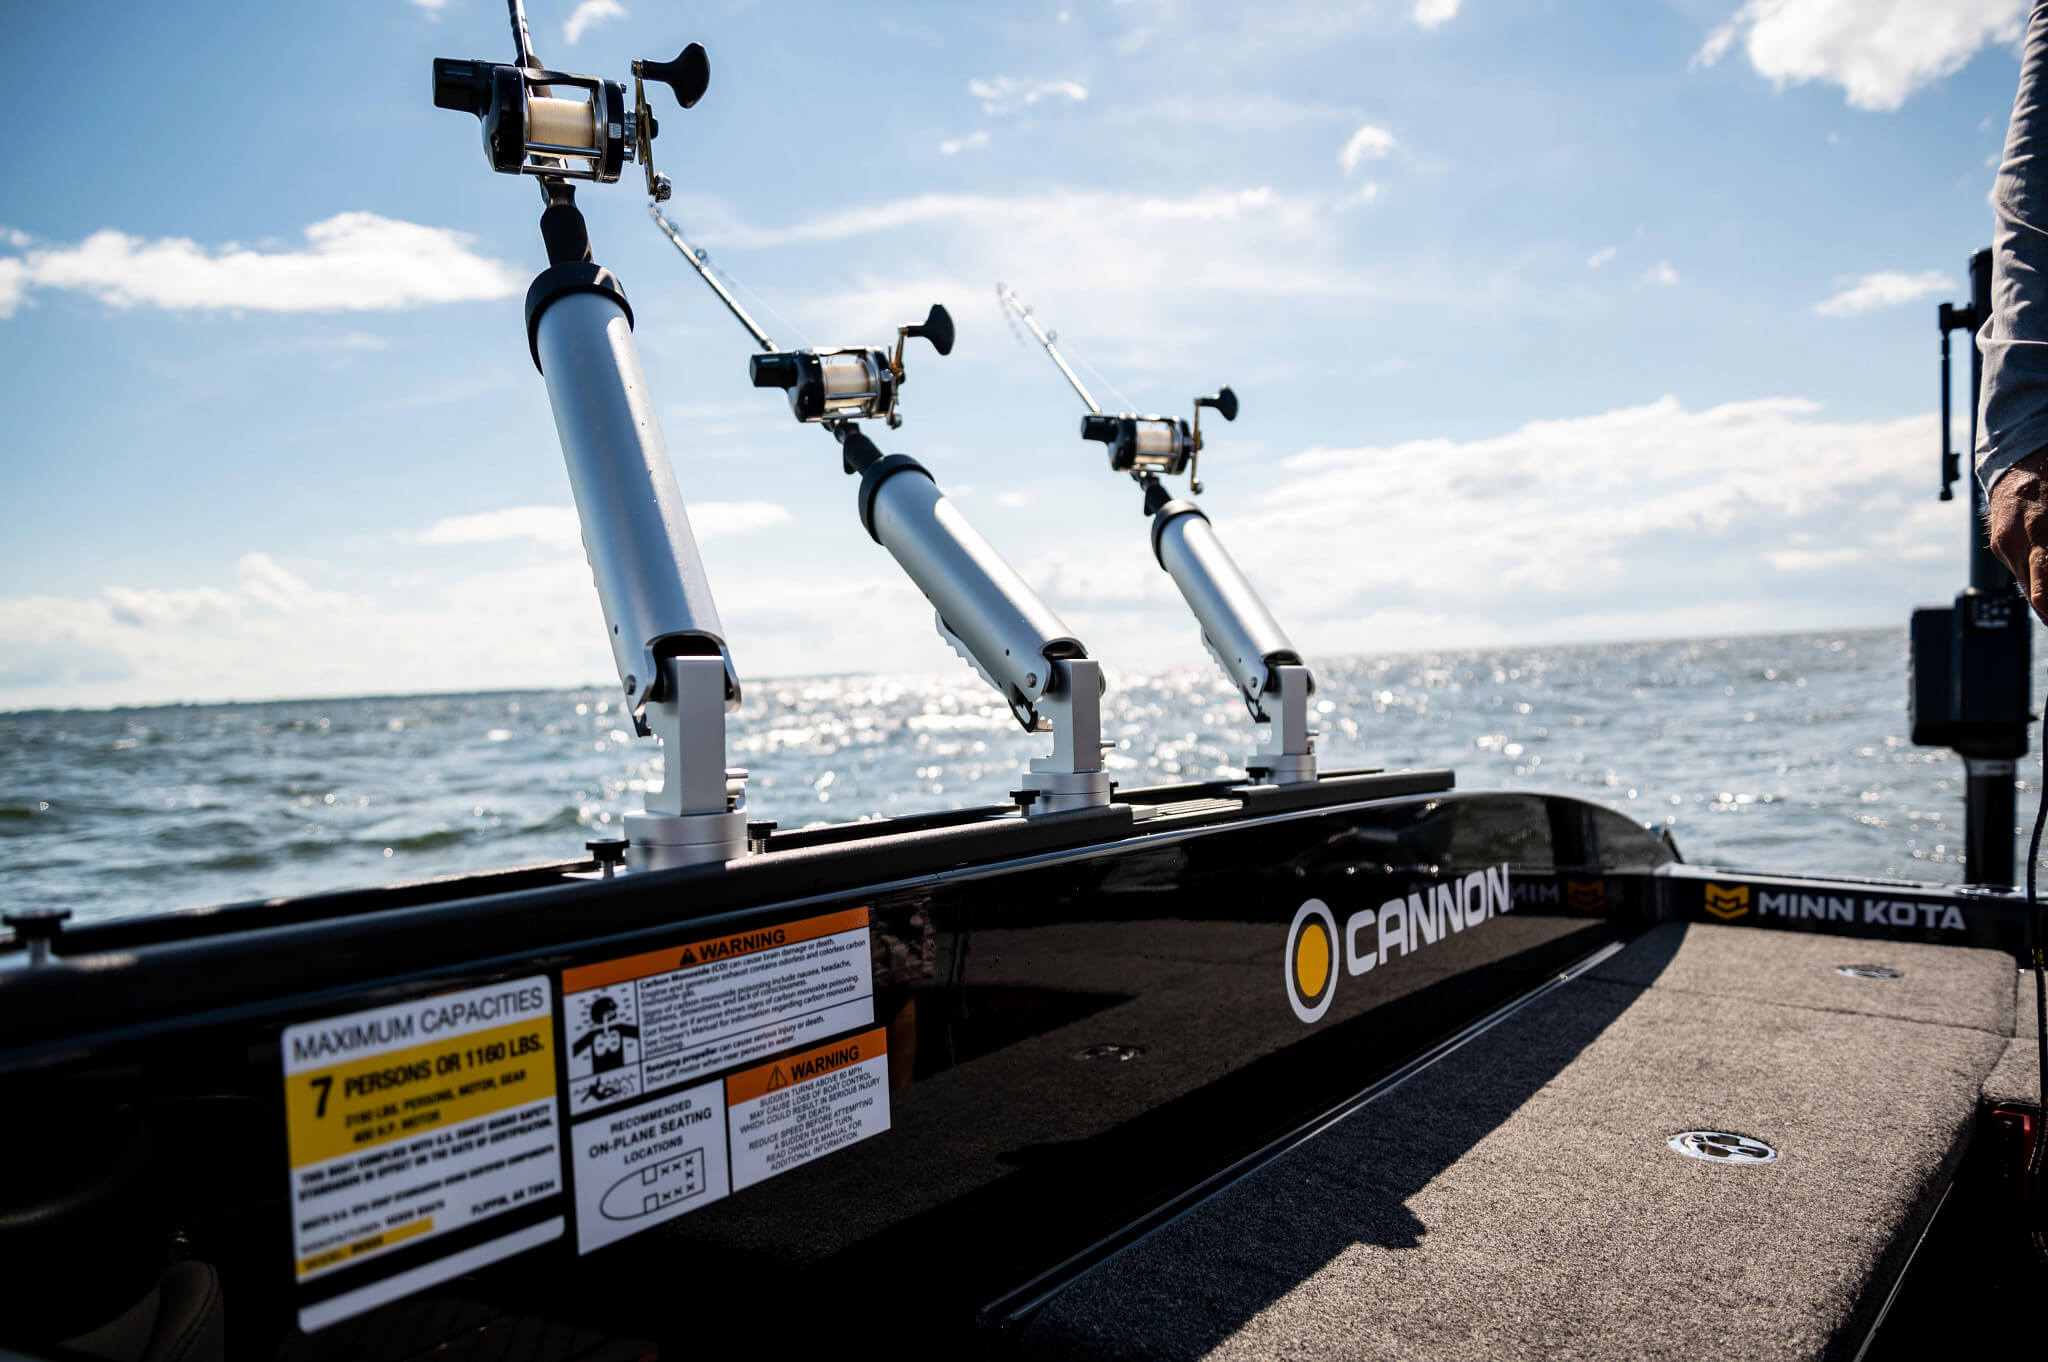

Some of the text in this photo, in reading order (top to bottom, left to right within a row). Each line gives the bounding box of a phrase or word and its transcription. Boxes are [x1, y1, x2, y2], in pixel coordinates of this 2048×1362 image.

[1346, 862, 1510, 967] CANNON
[1758, 891, 1966, 931] MINN KOTA
[699, 928, 785, 961] WARNING
[292, 985, 544, 1062] MAXIMUM CAPACITIES
[343, 1058, 431, 1100] PERSONS
[436, 1051, 460, 1076] OR
[509, 1031, 544, 1058] LBS.
[791, 1044, 859, 1081] WARNING
[309, 1073, 335, 1120] 7
[740, 1076, 879, 1134] WHICH COULD RESULT IN SERIOUS INJURY
[749, 1070, 871, 1120] MAY CAUSE LOSS OF BOAT CONTROL
[759, 1090, 789, 1107] SUDDEN
[791, 1081, 813, 1096] TURNS
[815, 1073, 837, 1088] ABOVE
[848, 1065, 862, 1076] MPH
[588, 1106, 711, 1159] ON-PLANE SEATING
[610, 1098, 692, 1134] RECOMMENDED
[749, 1096, 873, 1151] REDUCE SPEED BEFORE ATTEMPTING
[774, 1142, 778, 1150] A
[780, 1130, 808, 1148] SUDDEN
[810, 1121, 833, 1136] SHARP
[796, 1113, 806, 1123] OR
[623, 1134, 683, 1165] LOCATIONS
[766, 1119, 861, 1163] READ OWNER'S MANUAL FOR
[770, 1148, 811, 1171] ADDITIONAL
